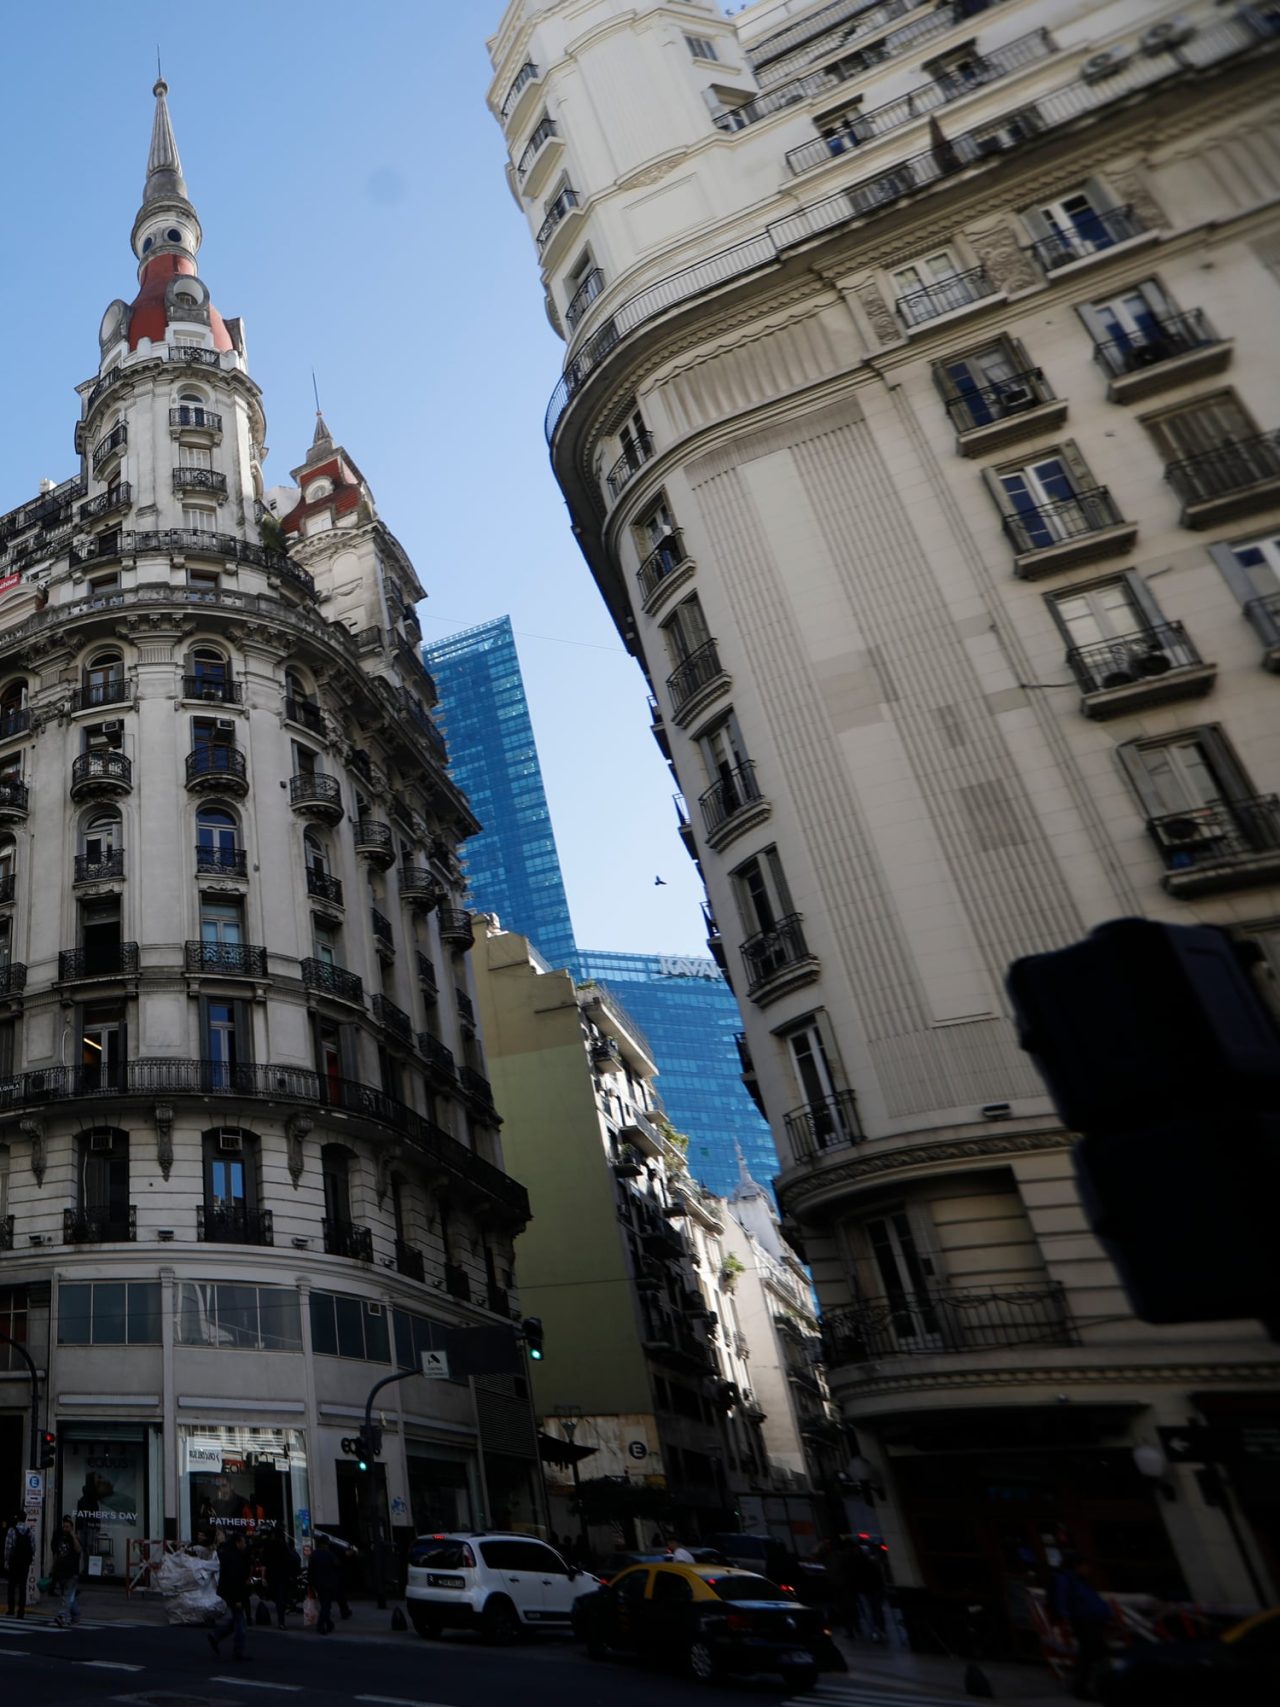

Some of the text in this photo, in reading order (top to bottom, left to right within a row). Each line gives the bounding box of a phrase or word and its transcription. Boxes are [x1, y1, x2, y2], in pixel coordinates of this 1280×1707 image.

[632, 1443, 642, 1457] E
[71, 1509, 138, 1521] FATHER'S DAY
[209, 1516, 256, 1527] FATHER'S
